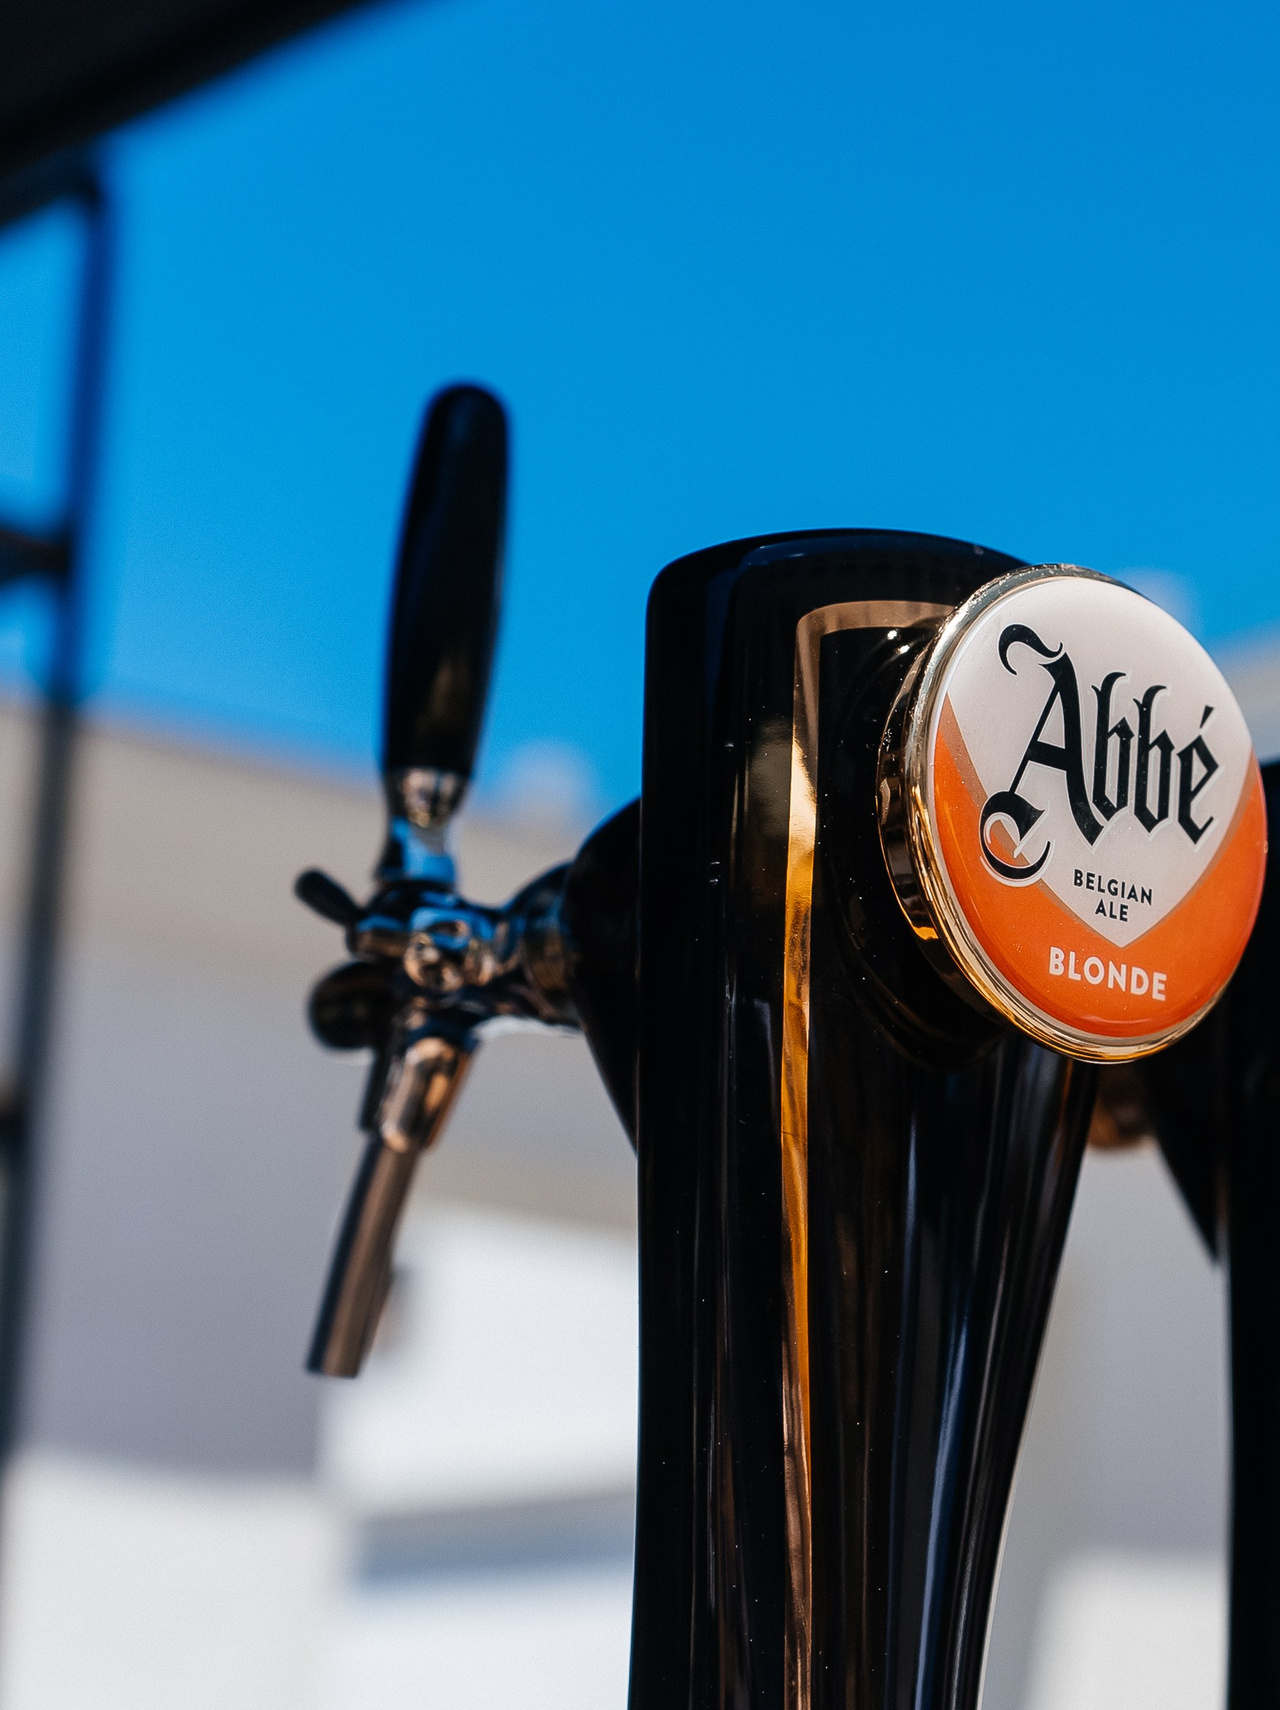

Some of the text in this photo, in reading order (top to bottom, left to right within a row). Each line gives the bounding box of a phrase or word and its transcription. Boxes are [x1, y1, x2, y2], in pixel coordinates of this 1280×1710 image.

[979, 624, 1219, 880] Abbé
[1074, 868, 1152, 906] BELGIAN
[1095, 898, 1129, 922] ALE
[1049, 946, 1167, 1001] BLONDE
